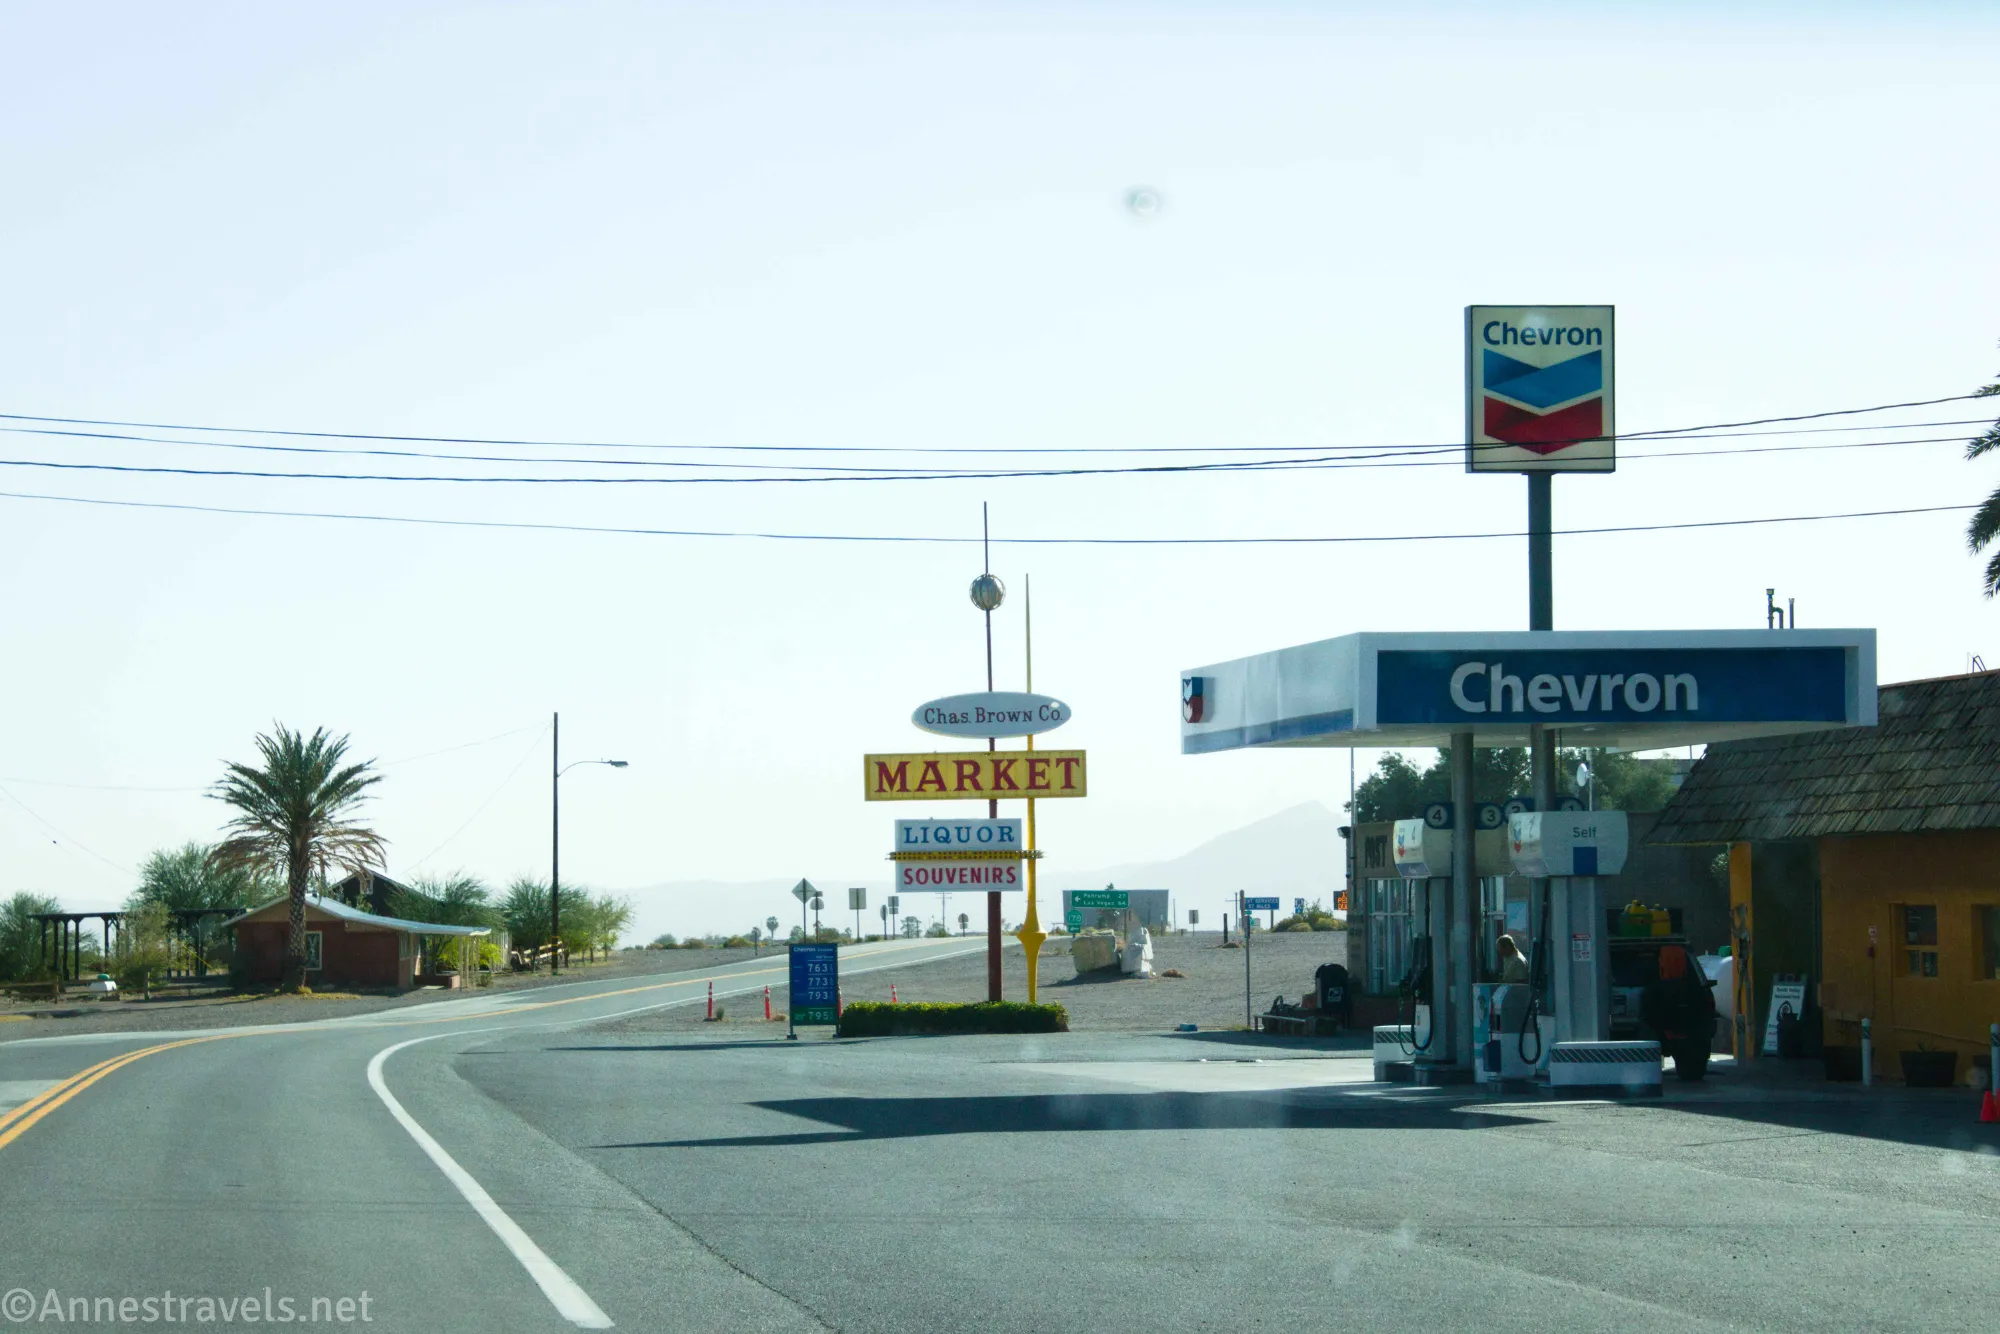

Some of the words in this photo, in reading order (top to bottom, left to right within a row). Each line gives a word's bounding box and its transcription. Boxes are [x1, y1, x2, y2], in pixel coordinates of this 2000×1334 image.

[1483, 320, 1602, 346] Chevron
[1450, 661, 1699, 714] Chevron
[975, 707, 1033, 724] Brown
[874, 757, 1080, 793] MARKET
[1432, 809, 1443, 822] 4
[1487, 809, 1496, 822] 3
[904, 825, 1015, 844] LIQUOR
[1572, 826, 1597, 838] Self
[904, 866, 1017, 885] SOUVENIRS
